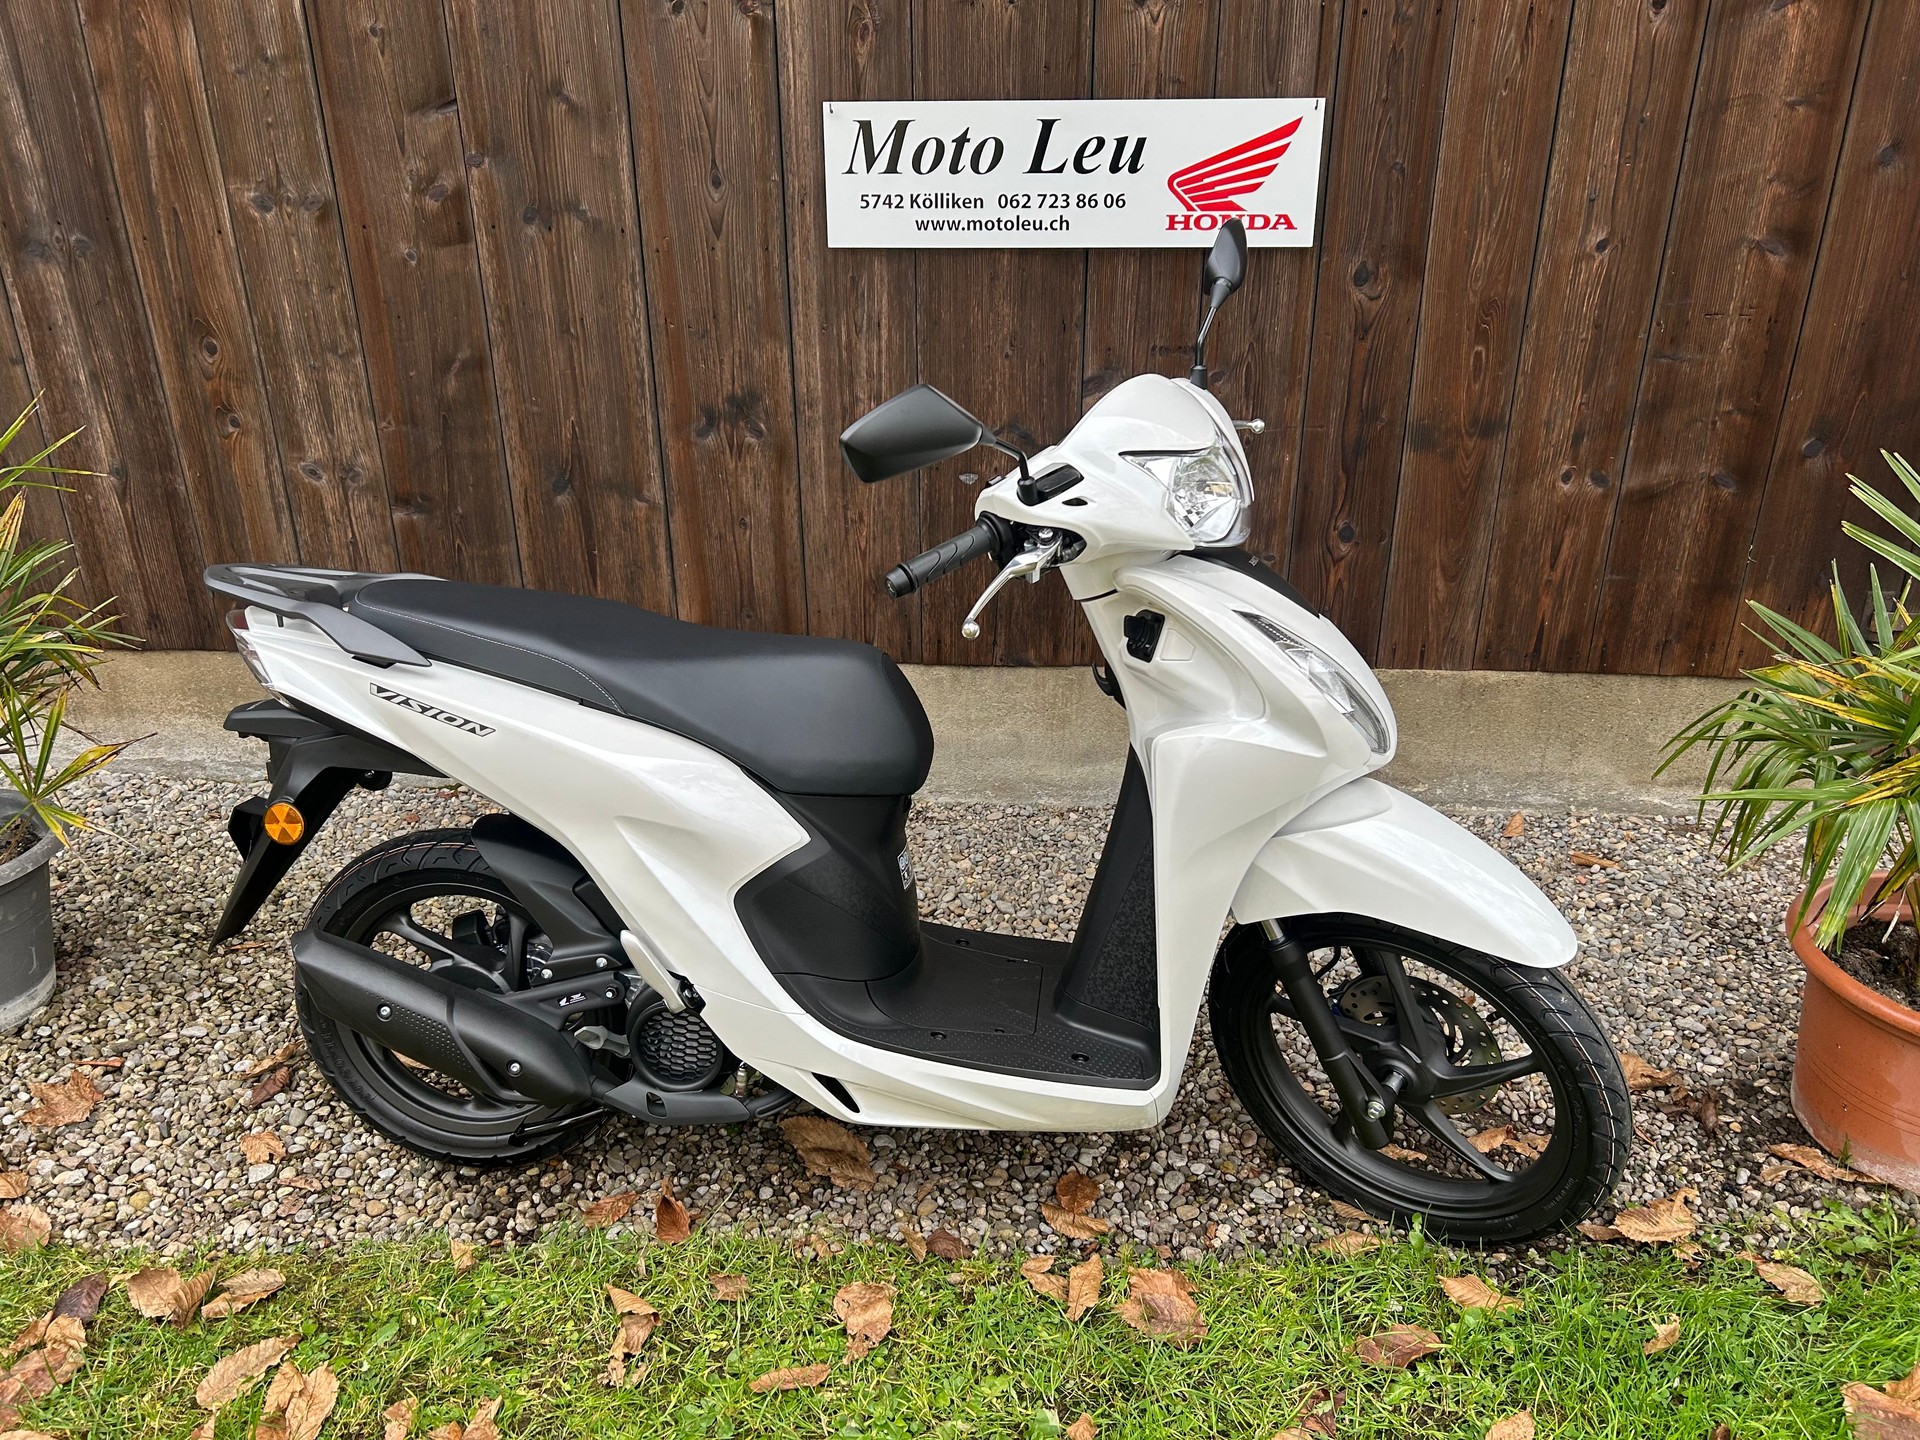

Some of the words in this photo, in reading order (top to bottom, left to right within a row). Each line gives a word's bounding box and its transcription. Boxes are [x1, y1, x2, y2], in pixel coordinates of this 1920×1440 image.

[841, 118, 1005, 175] Moto
[1022, 118, 1148, 175] Leu
[860, 193, 904, 209] 5742
[909, 192, 984, 209] Kölliken
[998, 193, 1031, 209] 062
[1037, 193, 1071, 209] 723
[1076, 193, 1099, 209] 86
[1103, 193, 1127, 209] 06
[914, 214, 1070, 232] www.motoleu.ch
[369, 682, 497, 737] VISION
